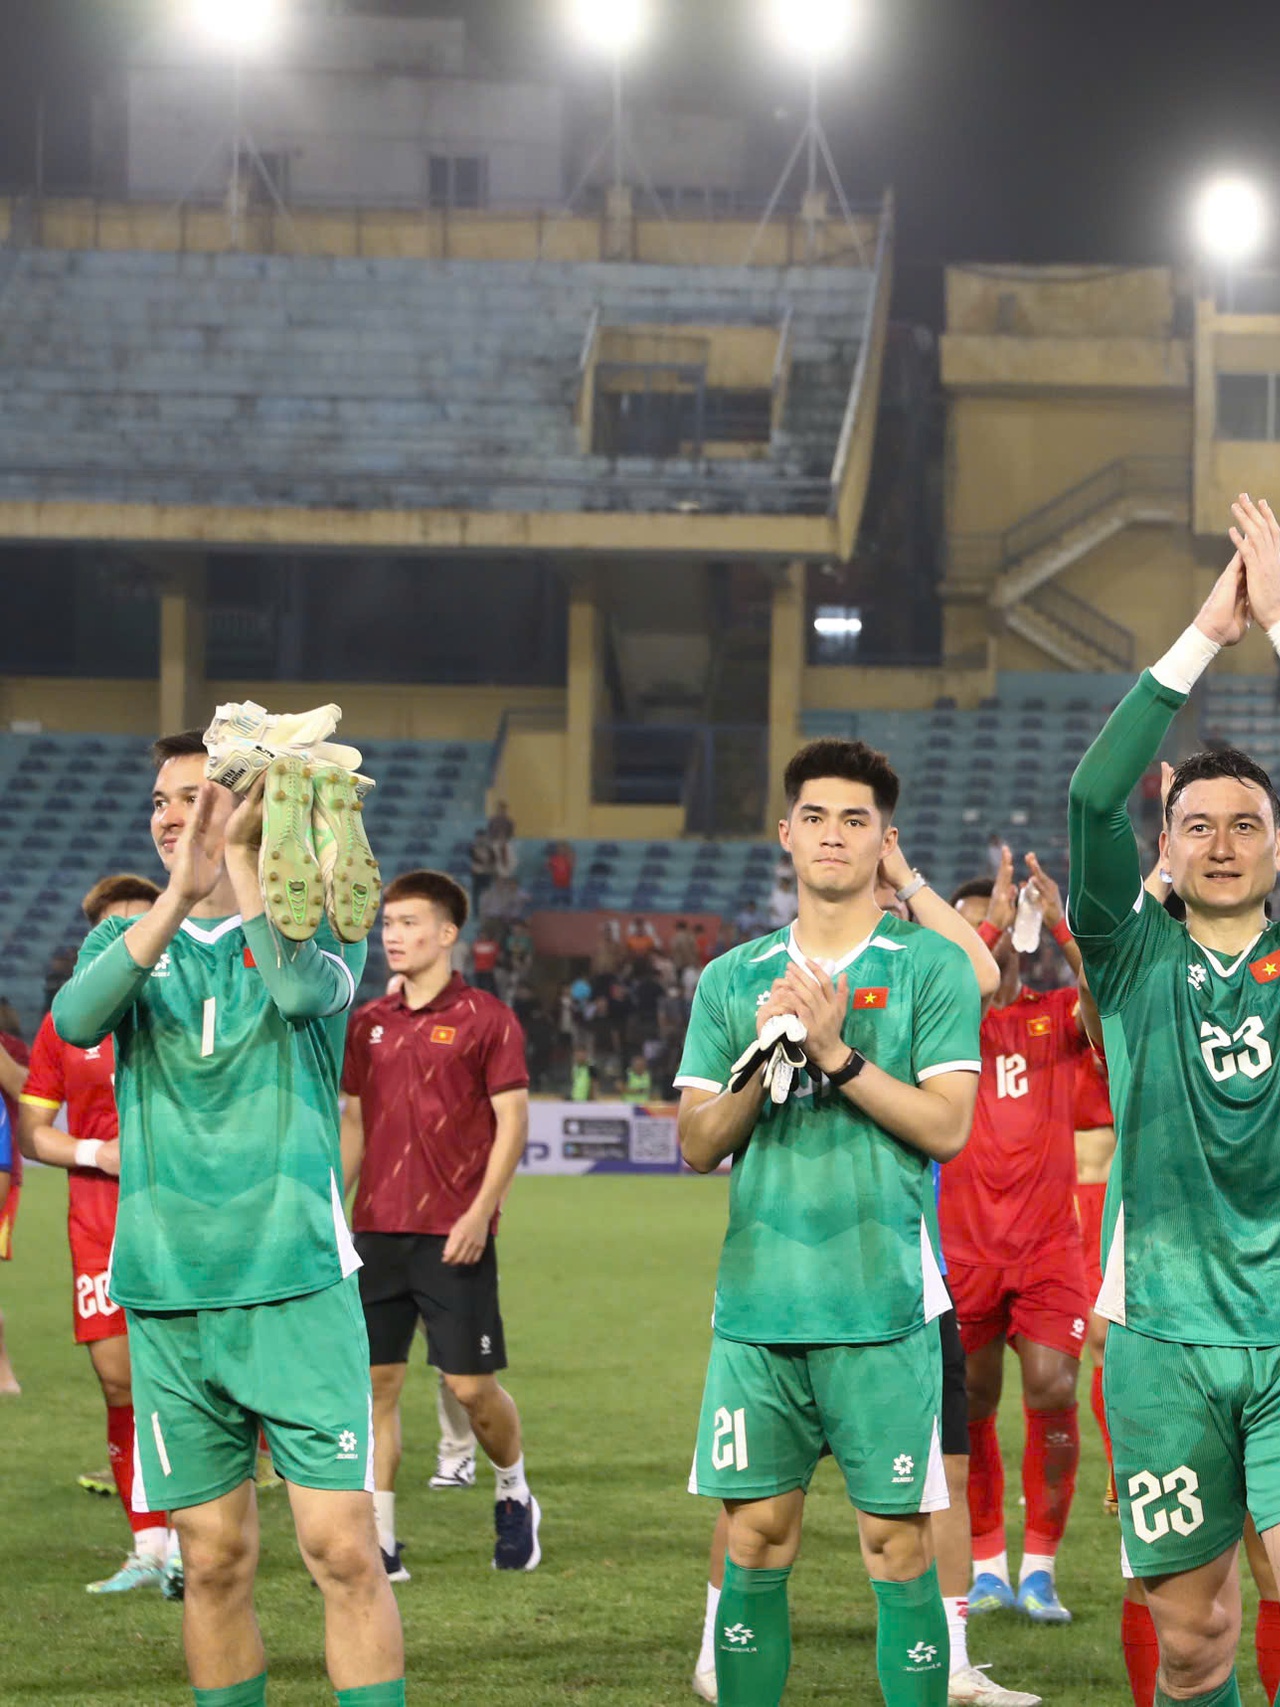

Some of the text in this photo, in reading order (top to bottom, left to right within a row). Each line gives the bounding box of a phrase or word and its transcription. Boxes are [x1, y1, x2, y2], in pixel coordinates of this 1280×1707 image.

[200, 997, 216, 1058] 1
[1200, 1015, 1272, 1083] 23
[996, 1053, 1029, 1099] 12
[76, 1271, 120, 1320] 20
[151, 1411, 172, 1477] 1
[711, 1406, 748, 1472] 21
[1128, 1464, 1204, 1545] 23
